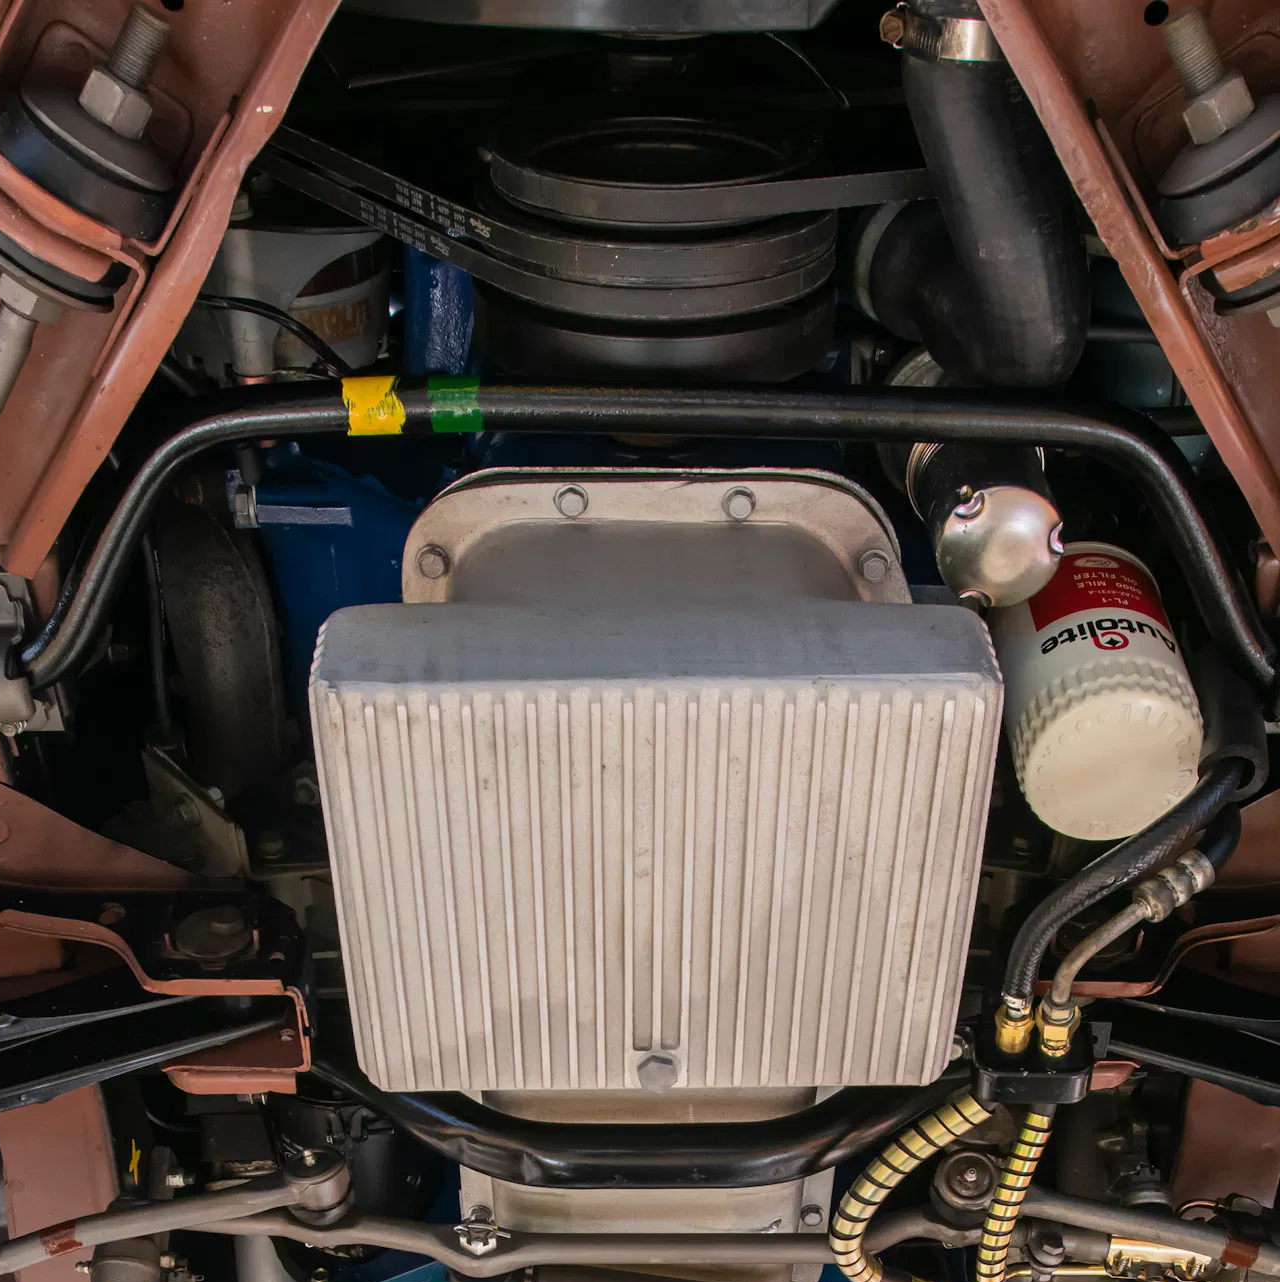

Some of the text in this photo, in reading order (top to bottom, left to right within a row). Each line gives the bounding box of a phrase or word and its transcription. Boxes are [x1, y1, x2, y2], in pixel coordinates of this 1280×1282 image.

[1073, 571, 1139, 587] OIL FILTER
[1075, 579, 1107, 591] MILE
[1100, 596, 1130, 607] FL-1
[1040, 618, 1177, 655] Autolite
